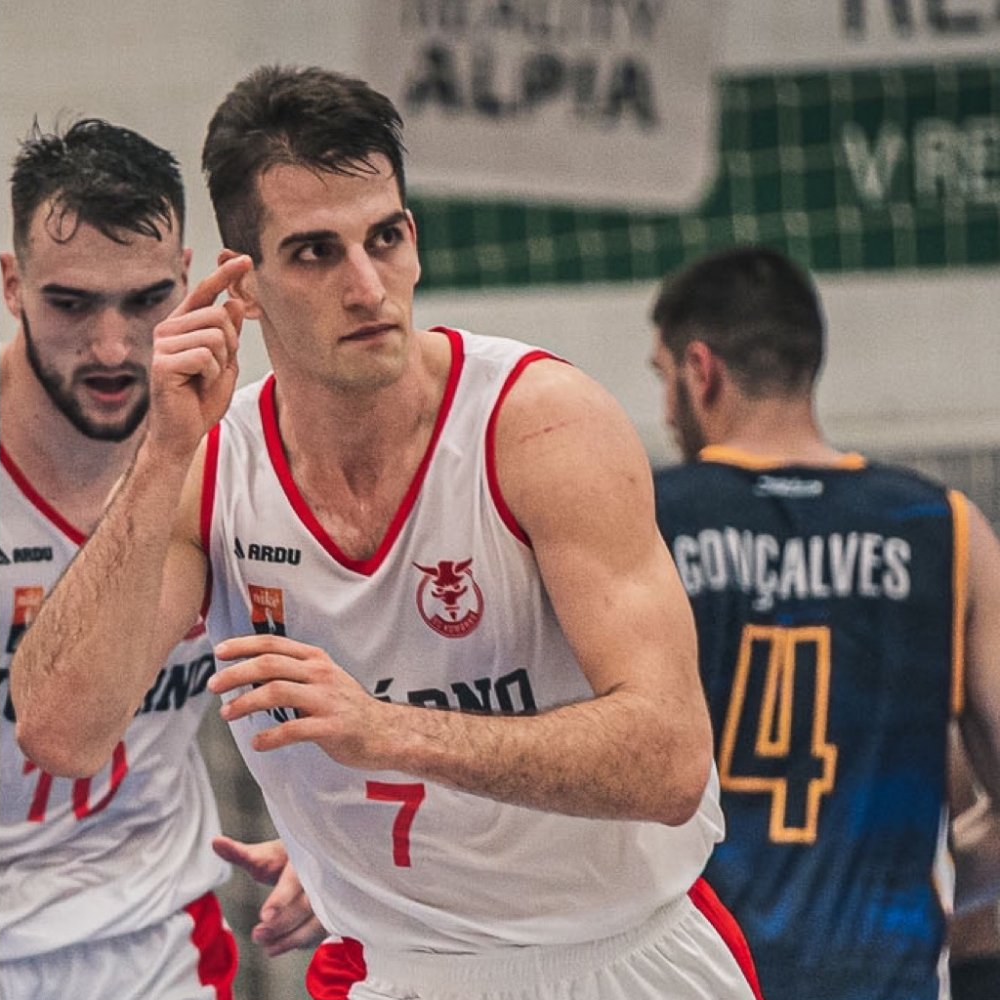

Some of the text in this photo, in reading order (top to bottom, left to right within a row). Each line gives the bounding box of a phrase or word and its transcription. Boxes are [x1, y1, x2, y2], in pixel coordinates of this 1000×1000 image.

[404, 42, 658, 130] ALPIA
[248, 543, 302, 566] ARDU
[673, 526, 912, 611] GONÇALVES
[719, 624, 839, 844] 4
[366, 780, 426, 868] 7
